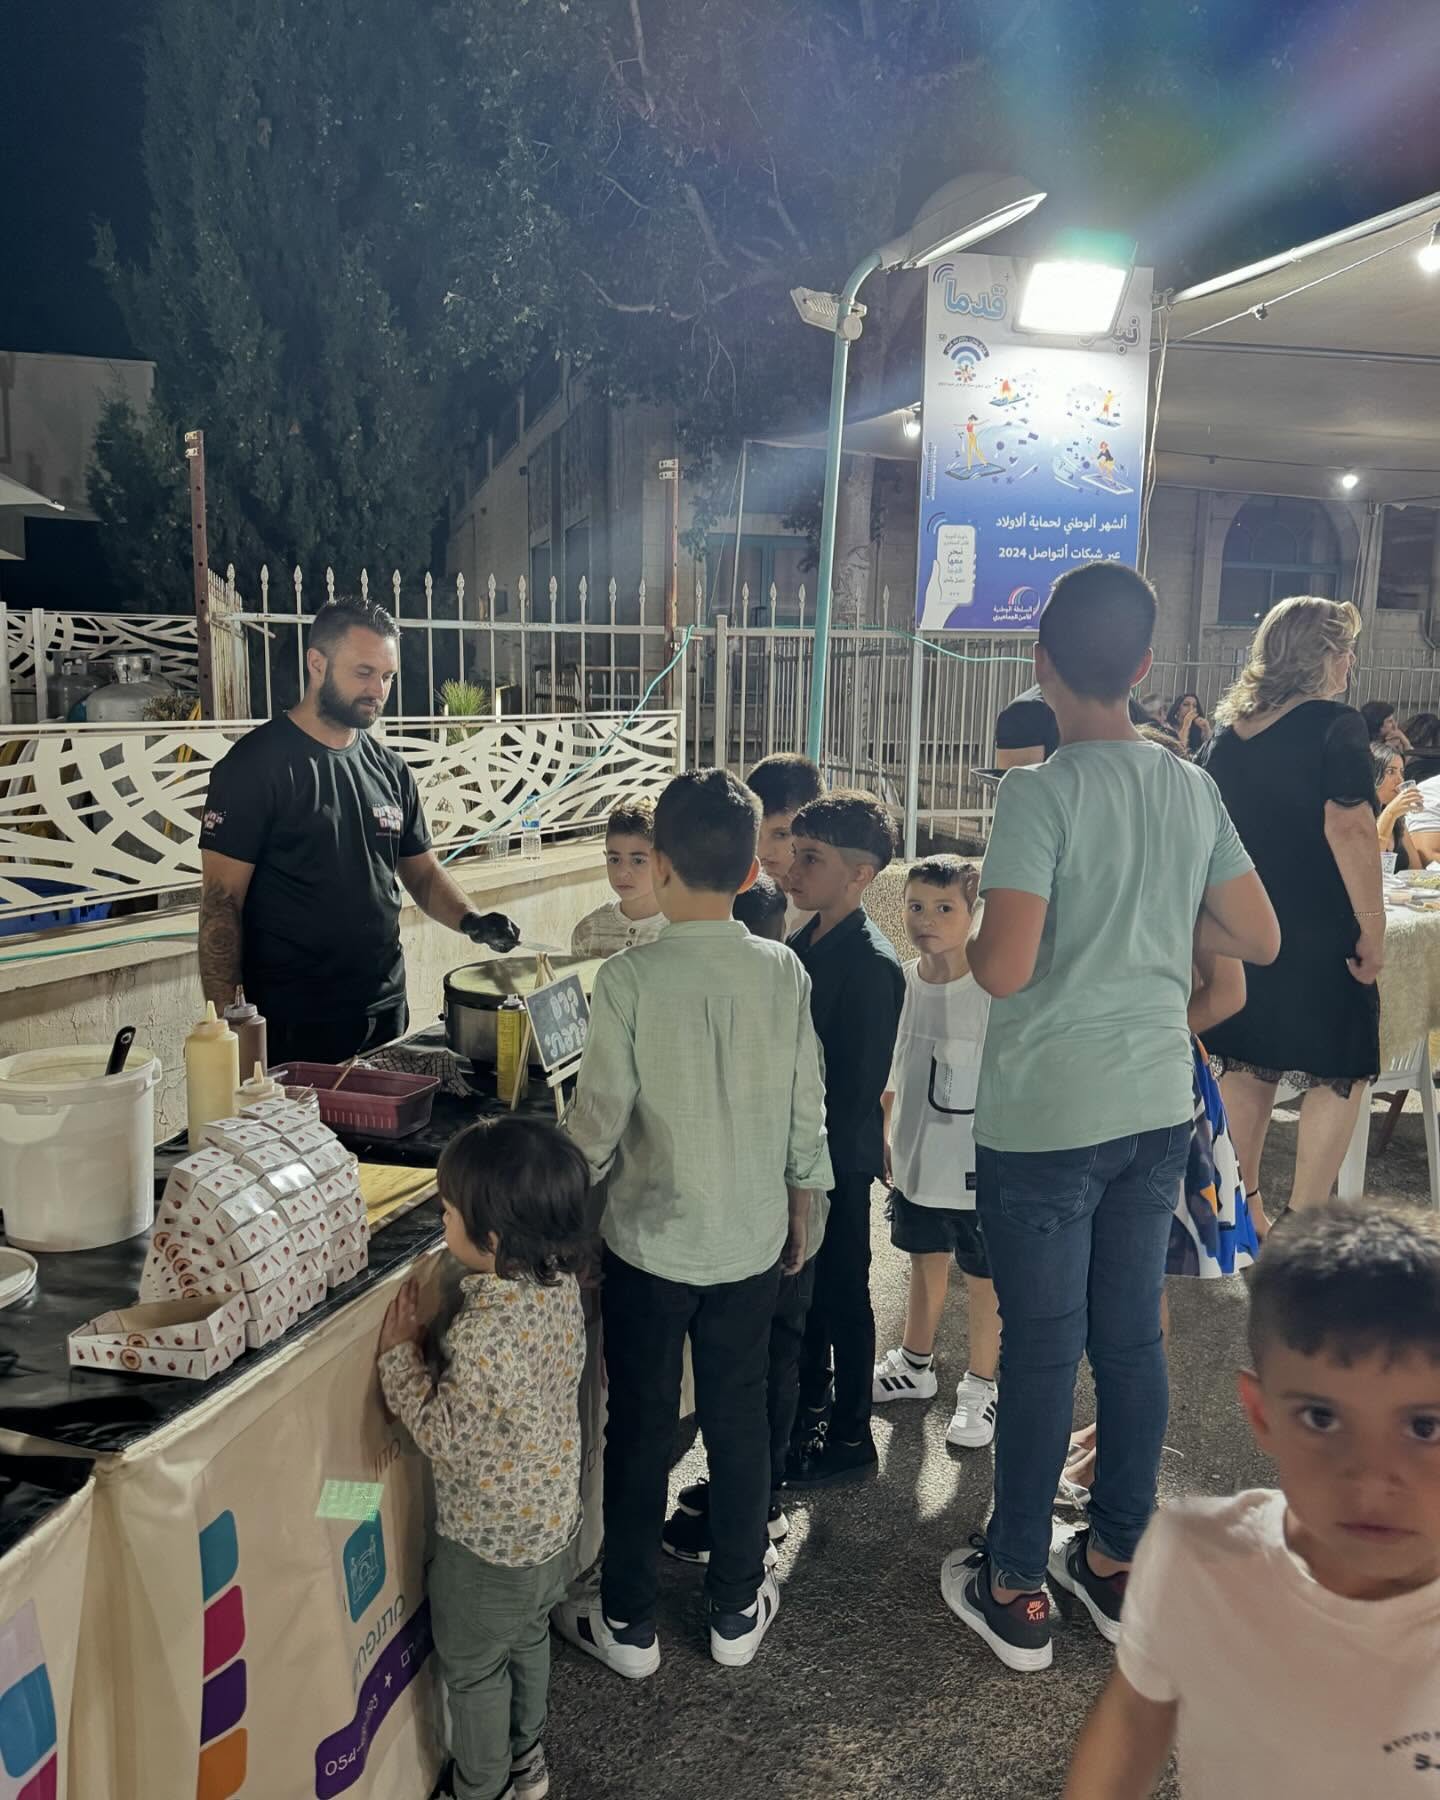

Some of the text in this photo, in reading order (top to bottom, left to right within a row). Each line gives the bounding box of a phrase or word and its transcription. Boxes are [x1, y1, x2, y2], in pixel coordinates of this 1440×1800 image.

[1028, 514, 1061, 531] لحماية
[999, 548, 1027, 558] 2024
[1070, 547, 1104, 563] شبكات
[1028, 1611, 1045, 1621] AIR
